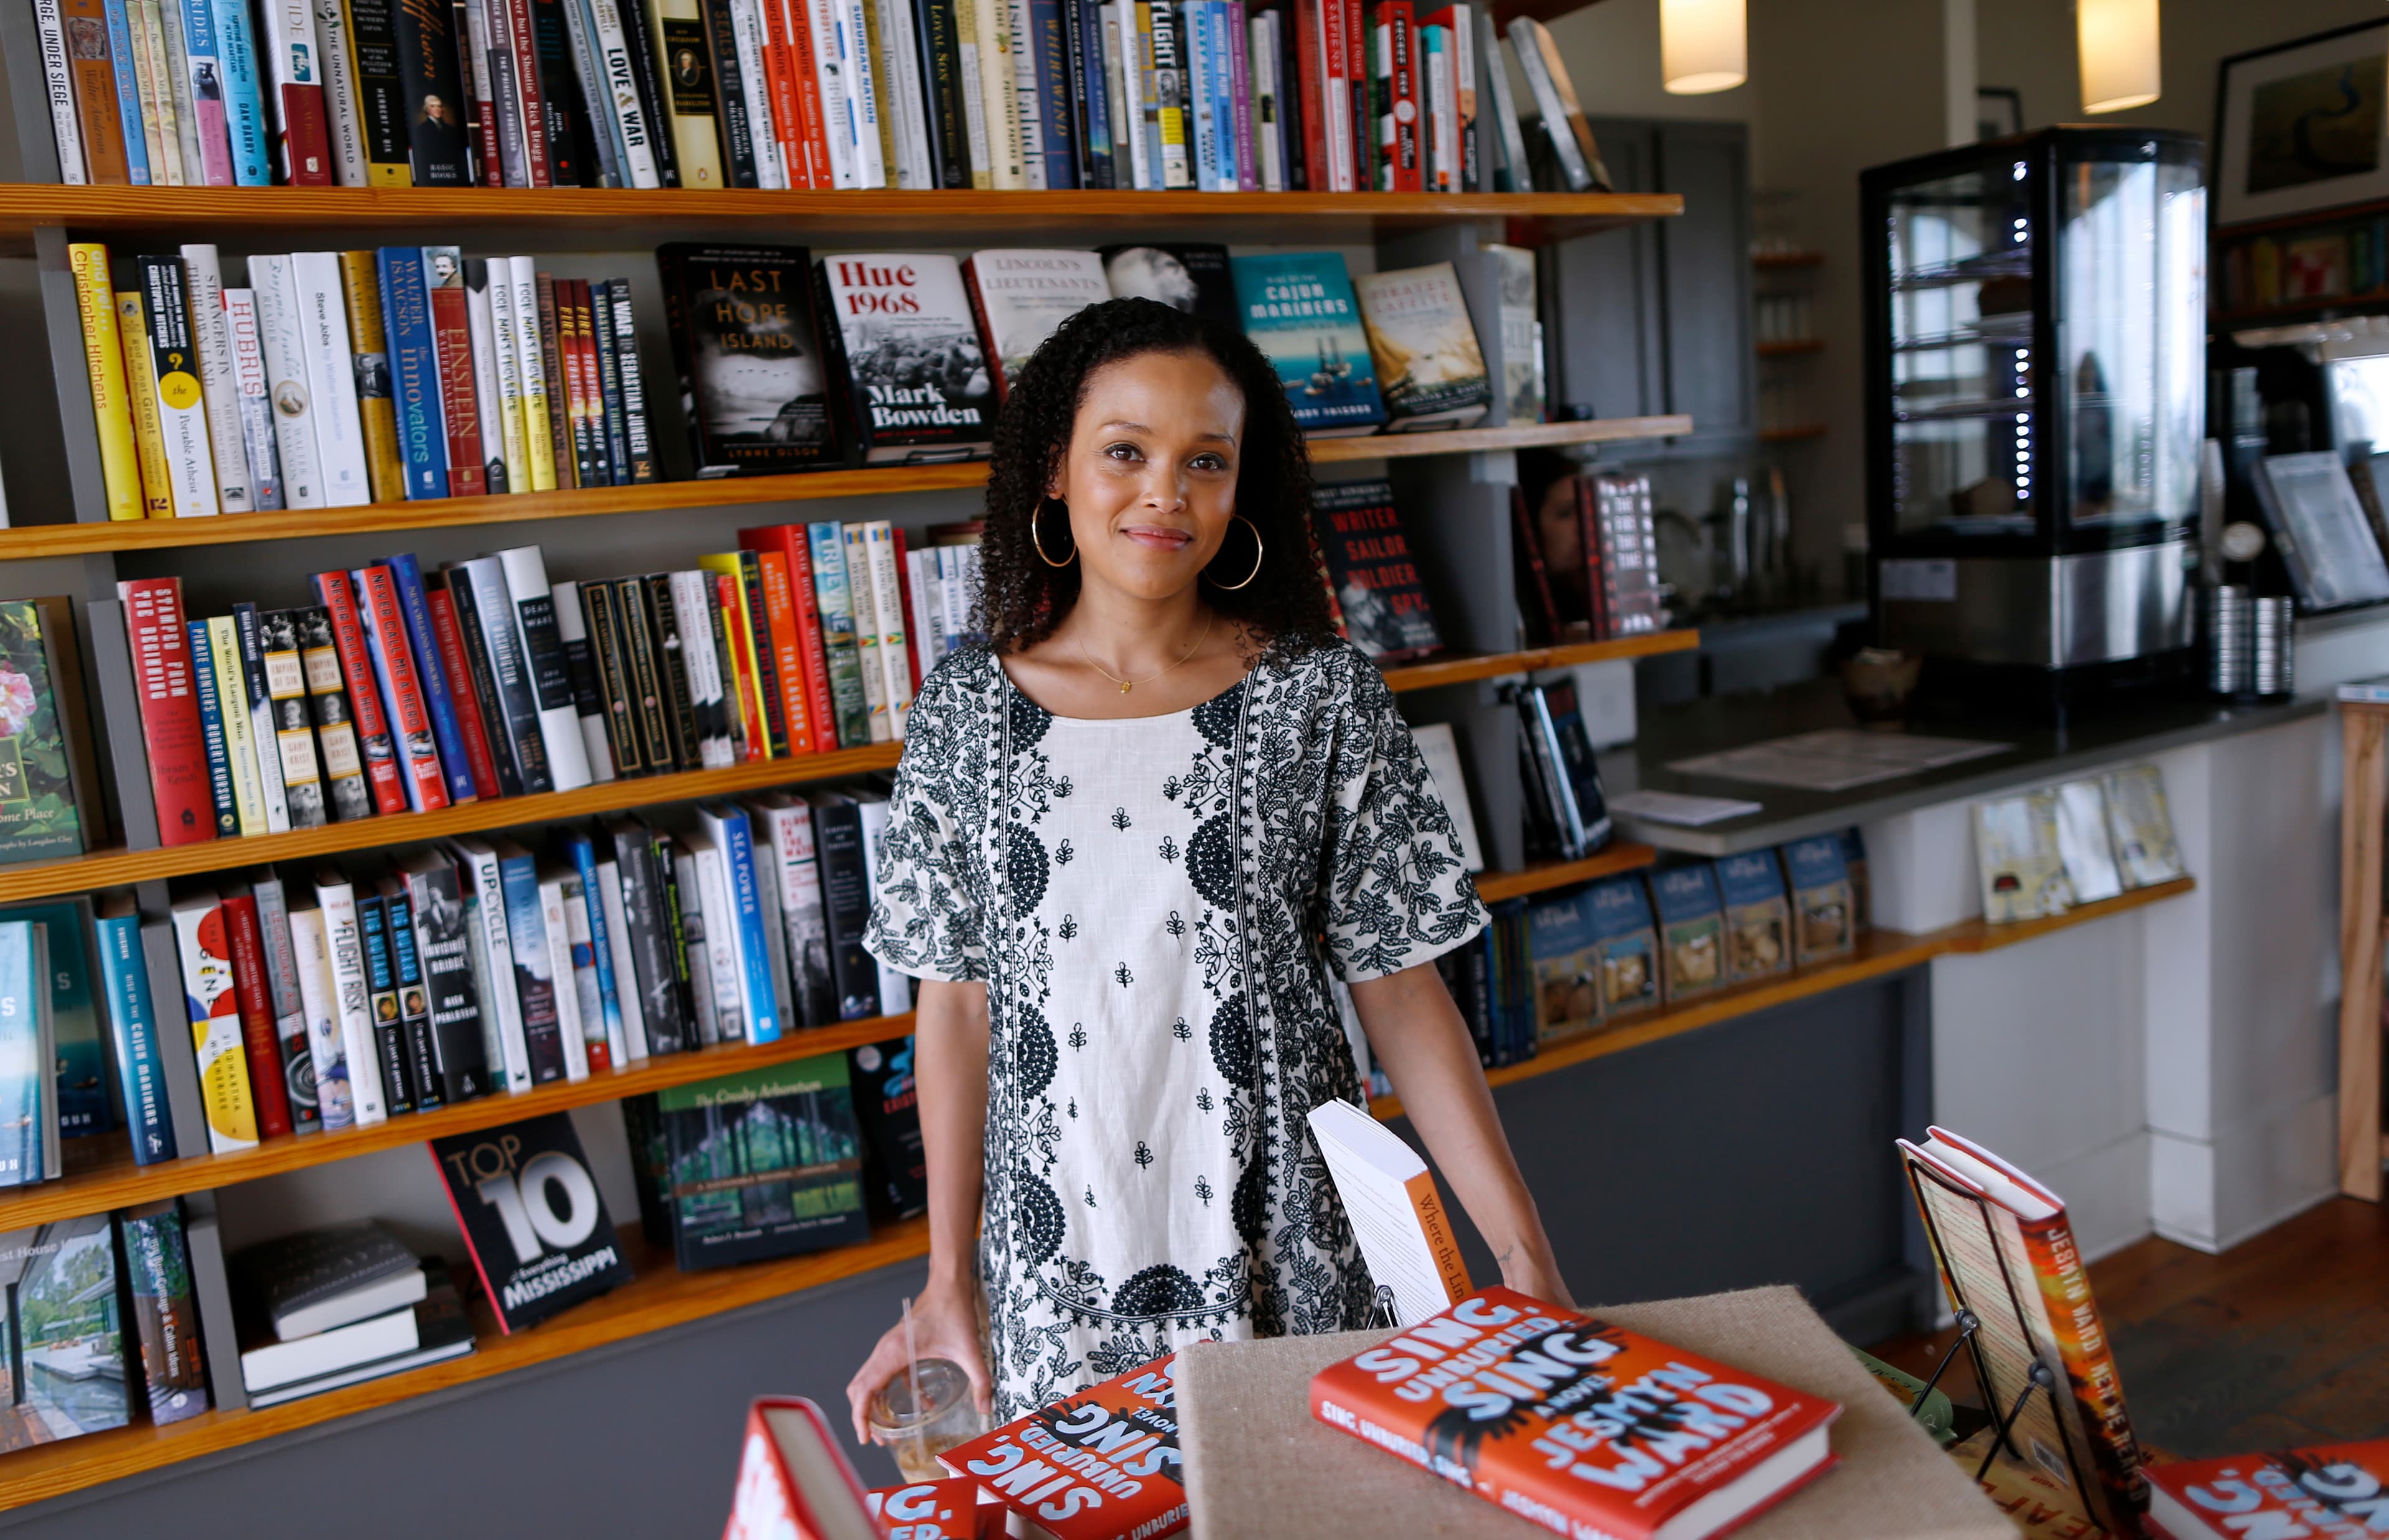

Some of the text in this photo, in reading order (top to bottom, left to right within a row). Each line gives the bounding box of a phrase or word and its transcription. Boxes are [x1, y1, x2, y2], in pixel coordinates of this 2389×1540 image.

[44, 29, 62, 68] UNDER
[165, 22, 178, 57] Dancing
[172, 59, 181, 78] with
[519, 37, 531, 51] the
[772, 26, 788, 75] Dawkins
[930, 4, 949, 81] LOYAL SON
[1150, 1, 1176, 67] FLIGHT
[51, 72, 68, 106] SIEGE
[85, 69, 99, 101] Walter
[328, 30, 355, 164] THE UNNATURAL WORLD
[607, 48, 645, 147] LOVE & WAR
[863, 78, 874, 124] NATION
[1045, 19, 1068, 137] WHIRLWIND
[90, 106, 105, 155] Anderson
[240, 103, 255, 154] DAN BARRY
[526, 102, 543, 126] Rick
[531, 131, 544, 163] Bragg
[91, 251, 107, 283] and
[710, 268, 783, 293] LAST
[837, 261, 916, 287] Hue
[985, 277, 1101, 290] LIEUTENANTS
[996, 259, 1082, 270] LINCOLN'S
[148, 265, 170, 349] CHRISTOPHER HITCHENS
[391, 260, 411, 336] ISAACSON
[405, 260, 424, 325] WALTER
[715, 302, 789, 325] HOPE
[846, 291, 920, 315] 1968
[1250, 299, 1348, 319] MARINERS
[1265, 283, 1326, 301] CAJUN
[74, 250, 108, 409] Christopher Hitchens
[185, 264, 215, 387] THEIR OWN LAND
[204, 274, 230, 376] STRANGERS IN
[559, 307, 575, 338] FIRE
[595, 295, 612, 348] SEBASTIAN
[720, 332, 795, 350] ISLAND
[231, 302, 263, 397] HUBRIS
[602, 351, 617, 389] JUNGER
[128, 338, 156, 435] god is not Great
[447, 328, 477, 438] EINSTEIN
[613, 300, 648, 455] WAR SEBASTIAN JUNGER
[866, 383, 947, 406] Mark
[401, 348, 429, 463] innovators
[872, 404, 981, 429] Bowden
[179, 415, 192, 453] Portable
[1330, 506, 1400, 532] WRITER.
[1344, 534, 1410, 561] SAILOR.
[821, 538, 850, 632] TRUEVINE
[1390, 591, 1430, 615] SPY.
[134, 590, 167, 700] THE BEGINNING
[155, 588, 180, 650] STAMPED
[329, 578, 348, 619] NEVER
[342, 625, 358, 658] CALL
[351, 662, 365, 680] ME
[359, 697, 376, 731] HERO
[372, 573, 393, 616] NEVER
[385, 621, 402, 654] CALL
[395, 658, 409, 677] ME
[403, 692, 421, 728] HERO
[165, 661, 188, 697] FROM
[781, 646, 806, 731] THE LAGOON
[192, 628, 232, 809] PIRATE HUNTERS ROBERT KURSON
[24, 807, 54, 822] Place
[732, 832, 755, 914] SEA POWER
[480, 863, 508, 949] UPCYCLE
[272, 910, 295, 985] LEGENDARY
[390, 902, 418, 982] TIG NOTARO
[432, 955, 465, 975] BRIDGE
[200, 949, 220, 1006] GENE
[334, 927, 367, 1017] FLIGHT RISK
[130, 1023, 159, 1126] CAJUN MARINERS
[445, 1134, 521, 1187] TOP
[474, 1150, 599, 1264] 10
[1420, 1194, 1444, 1245] Where
[1439, 1248, 1455, 1271] the
[17, 1241, 58, 1258] House
[519, 1252, 569, 1279] Everything
[503, 1245, 618, 1310] MISSISSIPPI
[162, 1314, 173, 1324] &
[163, 1324, 176, 1352] Cabin
[2071, 1302, 2101, 1353] WARD
[1442, 1332, 1621, 1423] SING
[1548, 1375, 1614, 1409] NOVEL
[2089, 1362, 2118, 1400] MEN
[1055, 1403, 1181, 1477] SING
[1137, 1405, 1178, 1433] NOVEL
[1532, 1361, 1713, 1471] JESMYN
[1570, 1383, 1776, 1493] WARD
[2102, 1403, 2126, 1429] WE
[967, 1434, 1102, 1521] SING,
[1019, 1421, 1143, 1499] UNBURIED,
